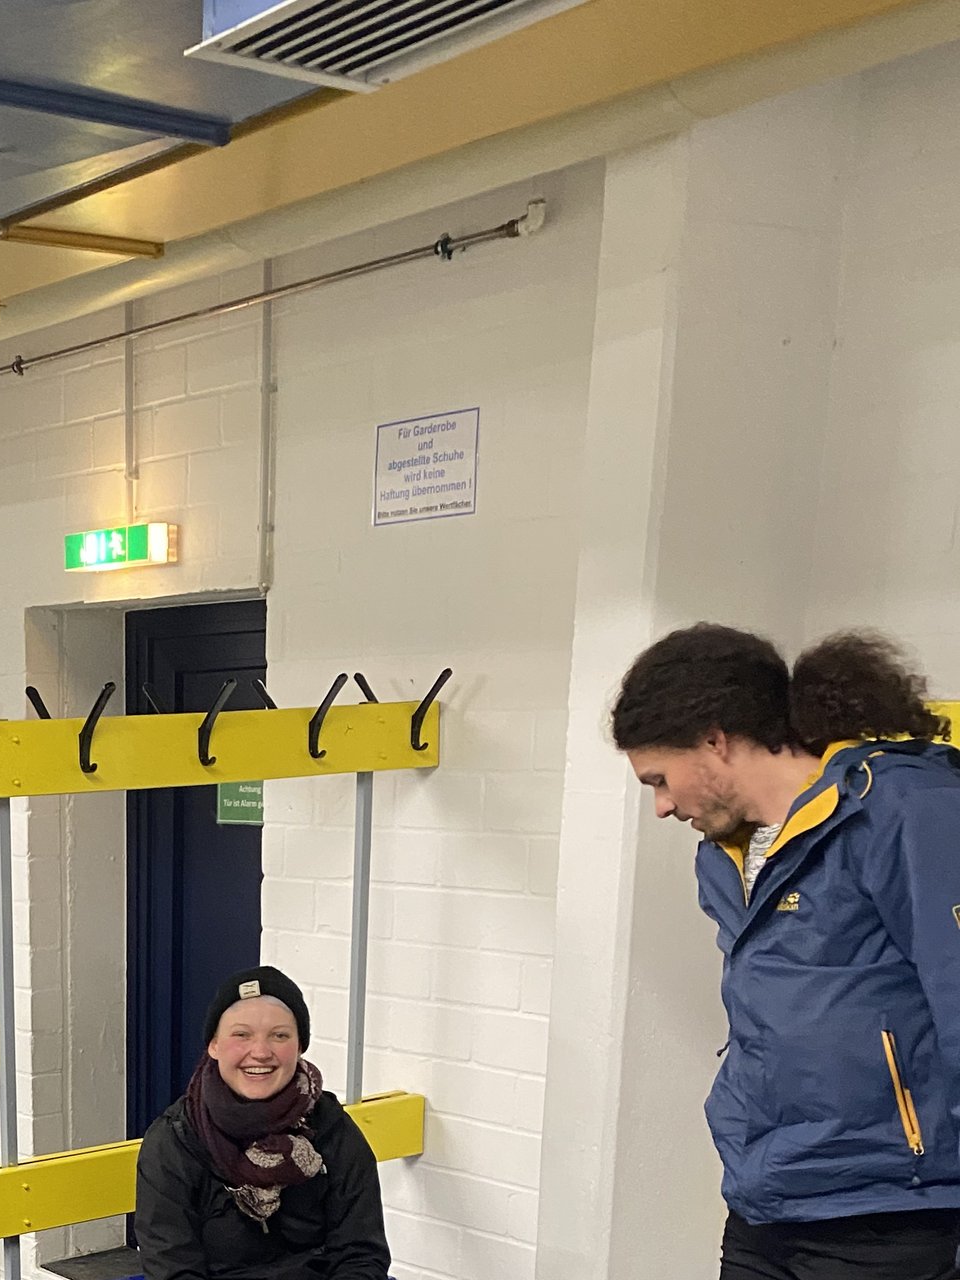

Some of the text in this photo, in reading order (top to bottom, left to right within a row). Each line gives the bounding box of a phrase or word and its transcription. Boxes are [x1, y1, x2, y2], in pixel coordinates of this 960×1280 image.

[398, 421, 457, 440] Für Garderobe
[418, 439, 434, 451] und
[388, 450, 465, 471] abgestellte Schuhe
[404, 468, 445, 483] wird keine
[380, 487, 410, 502] Haftung
[412, 481, 467, 497] übernommen
[239, 785, 261, 794] Achtung
